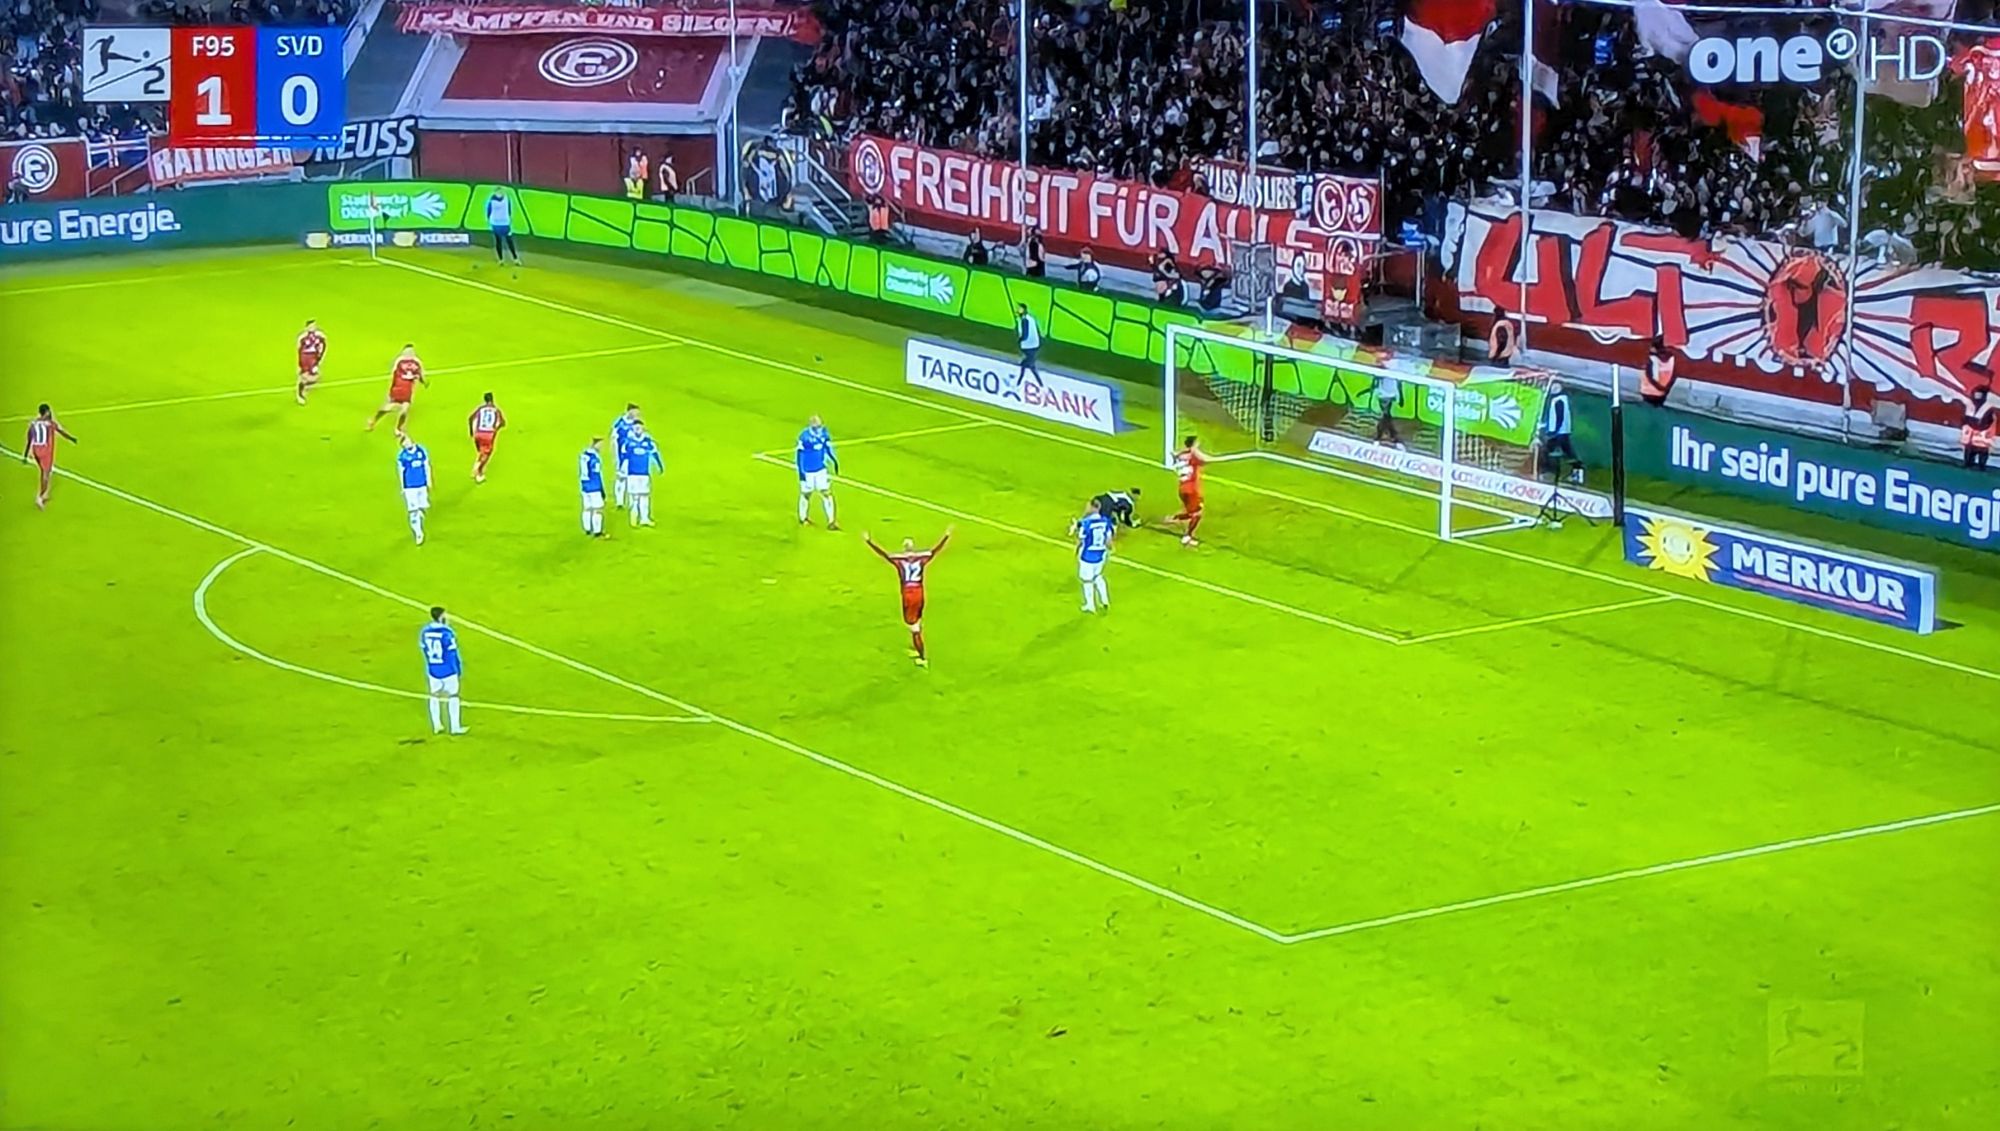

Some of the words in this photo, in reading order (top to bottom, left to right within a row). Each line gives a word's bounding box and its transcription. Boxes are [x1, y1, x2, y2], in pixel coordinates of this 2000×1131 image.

[596, 13, 654, 30] UND
[0, 219, 53, 244] ure
[59, 202, 182, 242] Energie.
[889, 145, 1079, 234] FREIHEIT
[1088, 180, 1179, 254] FÜR
[1671, 426, 1715, 472] Ihr
[1721, 442, 1789, 488] seid
[1797, 460, 1876, 506] pure
[1885, 468, 2000, 540] Energi
[902, 560, 922, 582] 12
[1732, 542, 1906, 612] MERKUR
